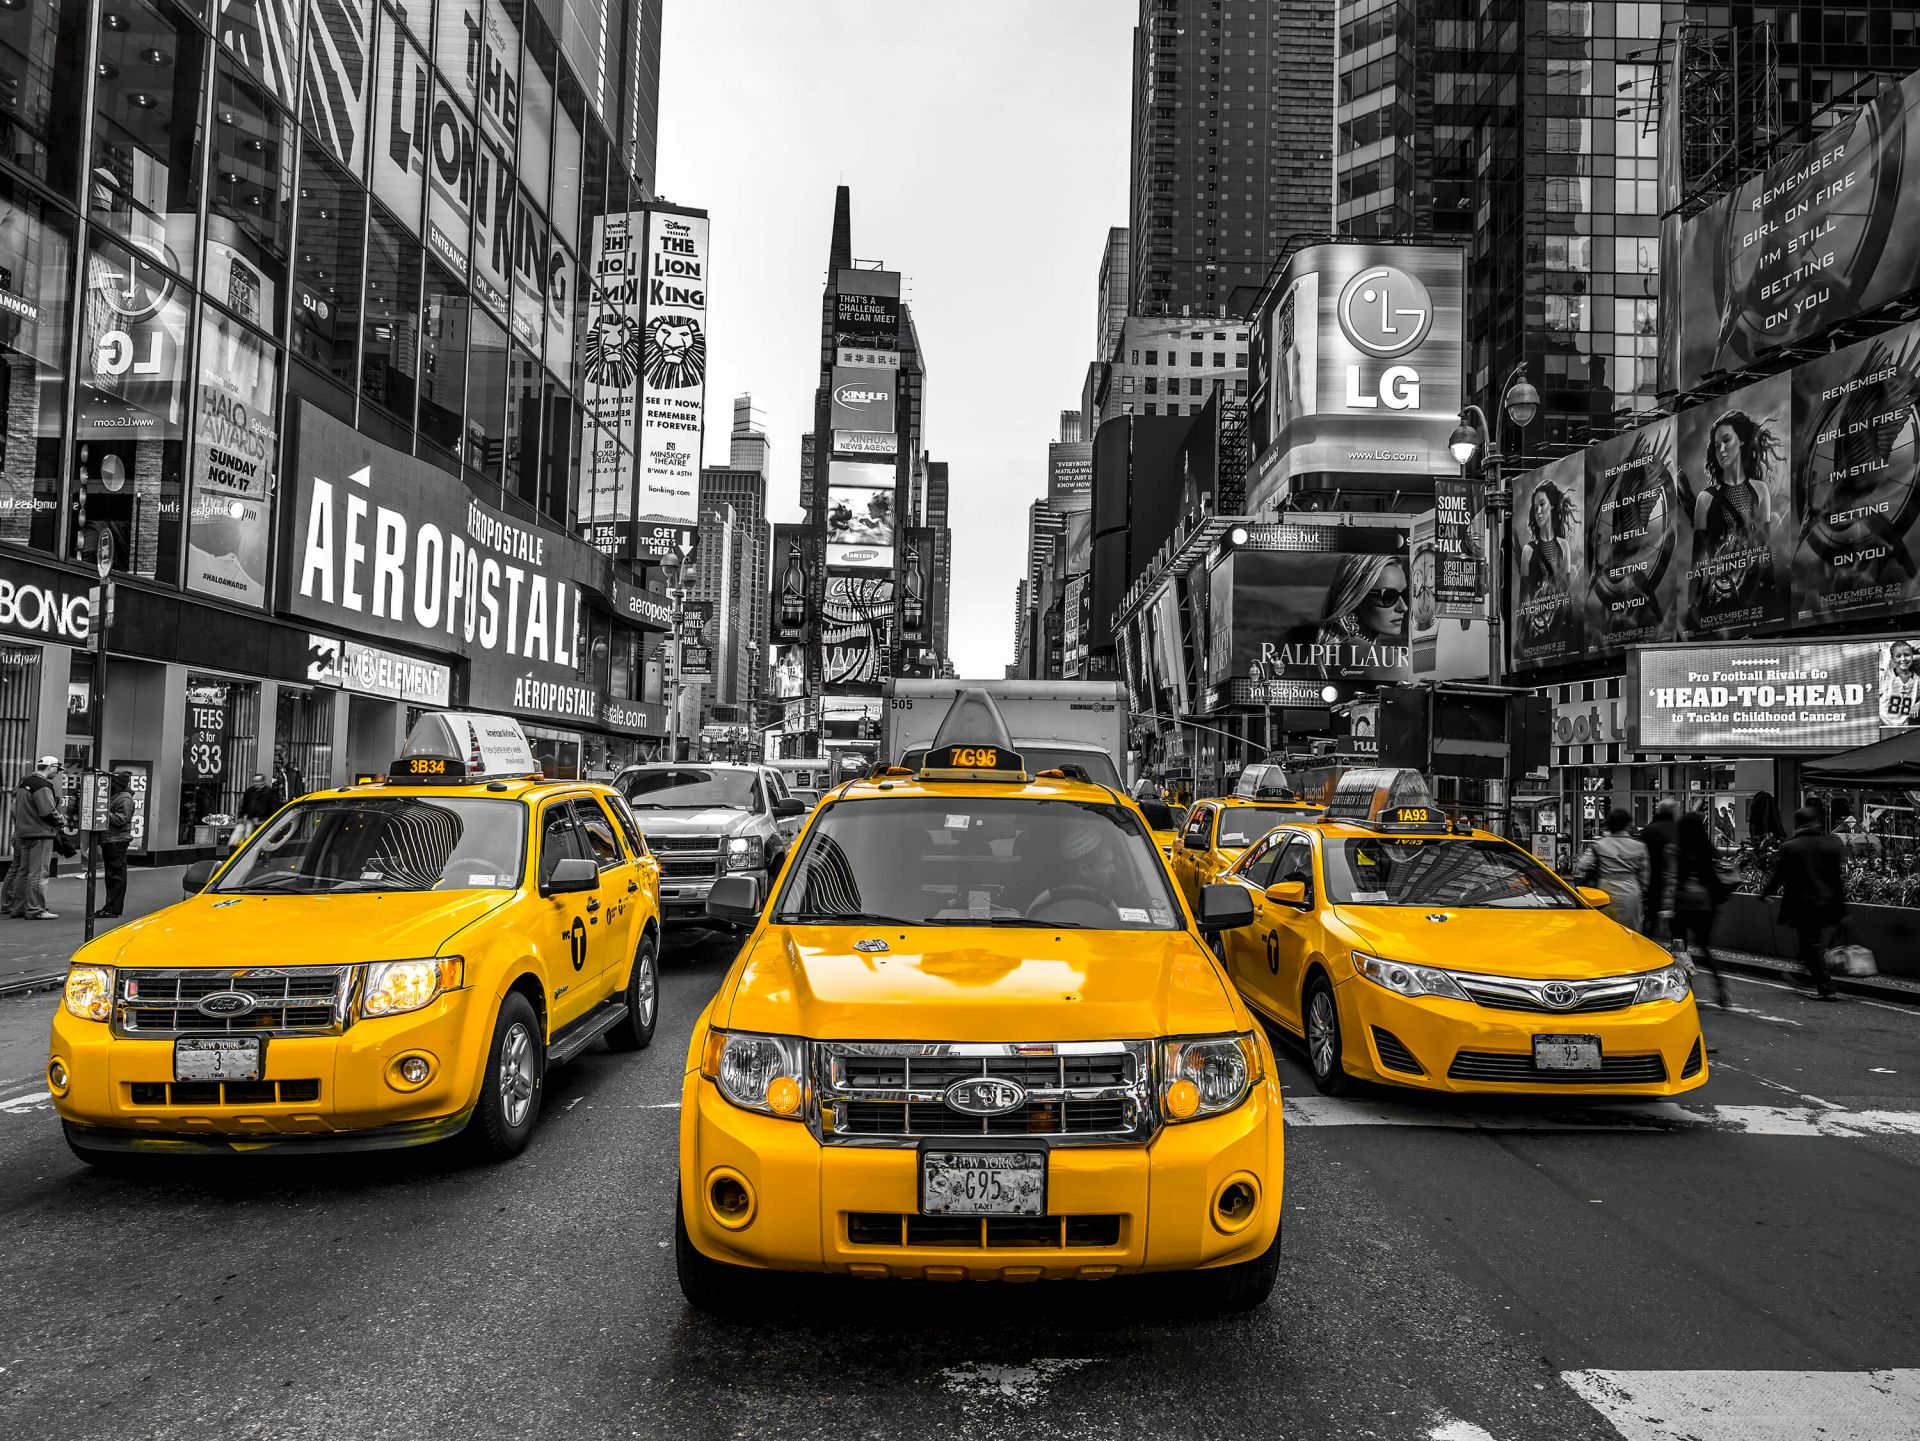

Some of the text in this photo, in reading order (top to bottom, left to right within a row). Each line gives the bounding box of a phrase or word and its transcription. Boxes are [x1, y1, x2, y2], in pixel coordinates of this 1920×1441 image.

[1752, 145, 1845, 212] REMEMBER
[1743, 171, 1856, 248] GIRL ON FIRE
[664, 219, 690, 232] Disney
[430, 228, 468, 273] ENTRANCE
[660, 236, 694, 253] THE
[1759, 219, 1836, 269] I'M STILL
[655, 253, 700, 276] LION
[1761, 252, 1834, 300] BETTING
[650, 278, 704, 306] KING
[840, 294, 867, 304] THAT'S
[839, 303, 885, 314] CHALLENGE
[1765, 288, 1830, 330] ON YOU
[512, 312, 531, 336] STREET
[839, 312, 896, 323] WE CAN MEET
[1346, 365, 1420, 410] LG
[1822, 367, 1897, 401] REMEMBER
[645, 397, 701, 409] SEE IT NOW.
[841, 390, 888, 401] XINHUA
[648, 410, 697, 421] REMEMBER
[657, 421, 700, 432] FOREVER.
[1816, 409, 1904, 445] GIRL ON FIRE
[840, 443, 862, 451] NEWS
[850, 434, 888, 444] XINHUA
[209, 448, 257, 477] SUNDAY
[650, 451, 691, 460] MINSKOFF
[654, 458, 686, 466] THEATRE
[1348, 451, 1417, 462] www.LG.com
[1605, 454, 1654, 478] REMEMBER
[1829, 459, 1889, 482] I'M STILL
[207, 466, 250, 492] NOV. 17
[649, 485, 690, 496] lionking.com
[1438, 496, 1466, 510] SOME
[1601, 488, 1658, 513] GIRL ON FIRE
[1438, 511, 1471, 525] WALLS
[1830, 502, 1890, 525] BETTING
[467, 499, 543, 566] AÉROPOSTALE
[654, 528, 677, 538] GET
[1250, 530, 1320, 545] sunglass hut
[1438, 525, 1458, 538] CAN
[1610, 528, 1648, 544] I'M STILL
[1438, 539, 1462, 553] TALK
[1696, 559, 1709, 568] THE
[1710, 551, 1740, 565] HUNGER
[1834, 546, 1886, 567] ON YOU
[730, 540, 742, 599] NOVOTEL
[1443, 561, 1476, 574] SPOTLIGHT
[1609, 561, 1648, 578] BETTING
[1685, 551, 1778, 581] CATCHING FIRE
[202, 573, 248, 591] #HALOAWARDS
[1443, 574, 1476, 587] BROADWAY
[1820, 582, 1902, 602] NOVEMBER 22
[0, 578, 90, 638] BONG
[1515, 602, 1556, 617] CATCHING
[1611, 597, 1645, 611] ON YOU
[684, 612, 702, 620] SOME
[1700, 606, 1763, 624] NOVEMBER 22
[683, 620, 705, 628] WALLS
[683, 637, 698, 645] TALK
[1603, 627, 1643, 640] NOVEMBER
[1261, 642, 1341, 666] RALPH
[378, 657, 440, 697] ELEMENT
[1688, 668, 1828, 682] Pro Football Rivals Go
[514, 671, 595, 718] AÉROPOSTALE
[891, 700, 913, 710] 505
[192, 707, 223, 730] TEES
[1671, 711, 1847, 723] to Tackle Childhood Cancer
[199, 731, 215, 743] 3 for
[190, 744, 222, 774] $33
[952, 748, 997, 767] 7G95
[410, 760, 446, 774] 3B34
[1268, 788, 1283, 796] 1P15
[1396, 807, 1428, 822] 1A93
[197, 1041, 240, 1050] NEW YORK
[214, 1051, 222, 1071] 3
[953, 1157, 1014, 1169] NEW YORK
[966, 1170, 1002, 1200] G95
